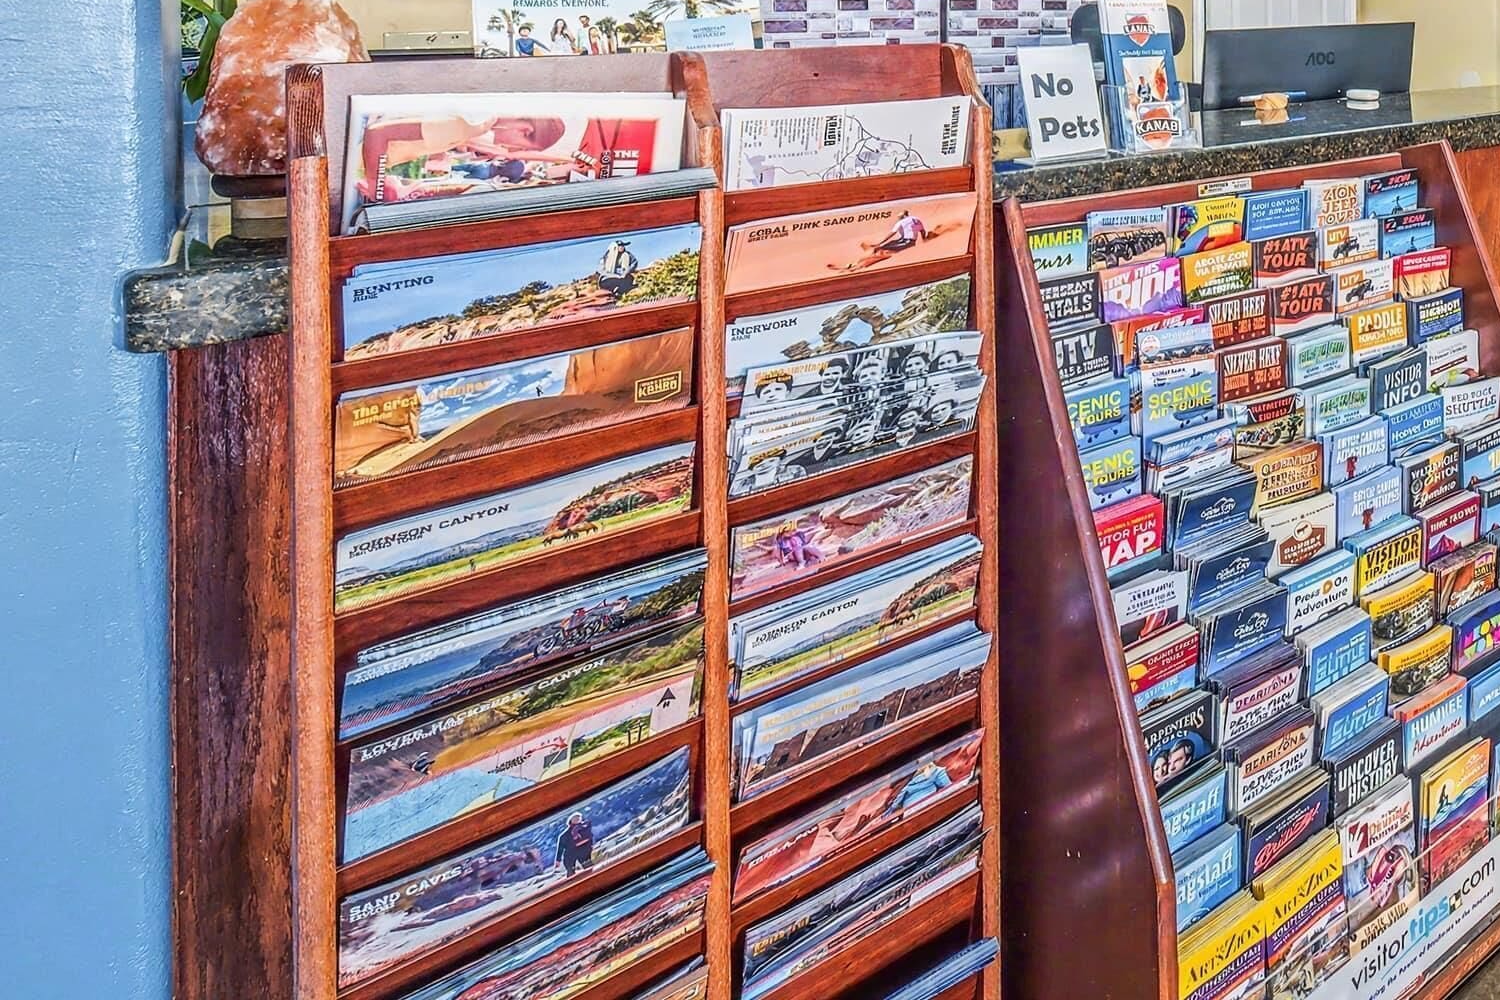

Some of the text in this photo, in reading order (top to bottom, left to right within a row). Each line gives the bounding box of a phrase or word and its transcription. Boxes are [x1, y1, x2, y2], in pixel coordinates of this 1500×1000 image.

[1305, 51, 1335, 66] AOC
[1031, 72, 1074, 98] No
[1038, 116, 1100, 142] Pets
[1136, 122, 1179, 136] KANAB
[1322, 183, 1359, 201] ZION
[1322, 197, 1358, 214] JEEP
[792, 220, 821, 231] PINK
[1317, 209, 1361, 228] TOURS
[1029, 229, 1083, 249] MMER
[1282, 235, 1310, 250] ATV
[1263, 252, 1308, 269] TOUR
[1107, 265, 1181, 312] RIDE
[1302, 281, 1326, 296] ATV
[1044, 294, 1092, 319] NTALS
[1280, 297, 1324, 316] TOUR
[1358, 306, 1403, 329] PADDLE
[1384, 363, 1422, 390] VISITOR
[1068, 390, 1121, 420] CENIC
[1148, 379, 1213, 409] SCENIC
[1384, 382, 1421, 408] INFO
[1446, 394, 1497, 415] SHUTTLE
[1080, 407, 1121, 426] TOURS
[1392, 423, 1421, 444] Hoover
[1082, 449, 1135, 478] CENIC
[1093, 467, 1135, 489] TOURS
[438, 503, 510, 530] CANYON
[1099, 519, 1157, 548] SITOR FUN
[1366, 533, 1420, 568] VISITOR
[1333, 575, 1348, 588] On
[811, 598, 858, 622] CANYON
[1294, 587, 1349, 620] Adventure
[537, 658, 606, 690] CANYON
[1144, 705, 1205, 750] ARPENTERS
[1338, 738, 1395, 793] UNCOVER
[1347, 755, 1399, 808] HISTORY
[1165, 786, 1220, 836] agstaff
[1177, 846, 1233, 904] agstaff
